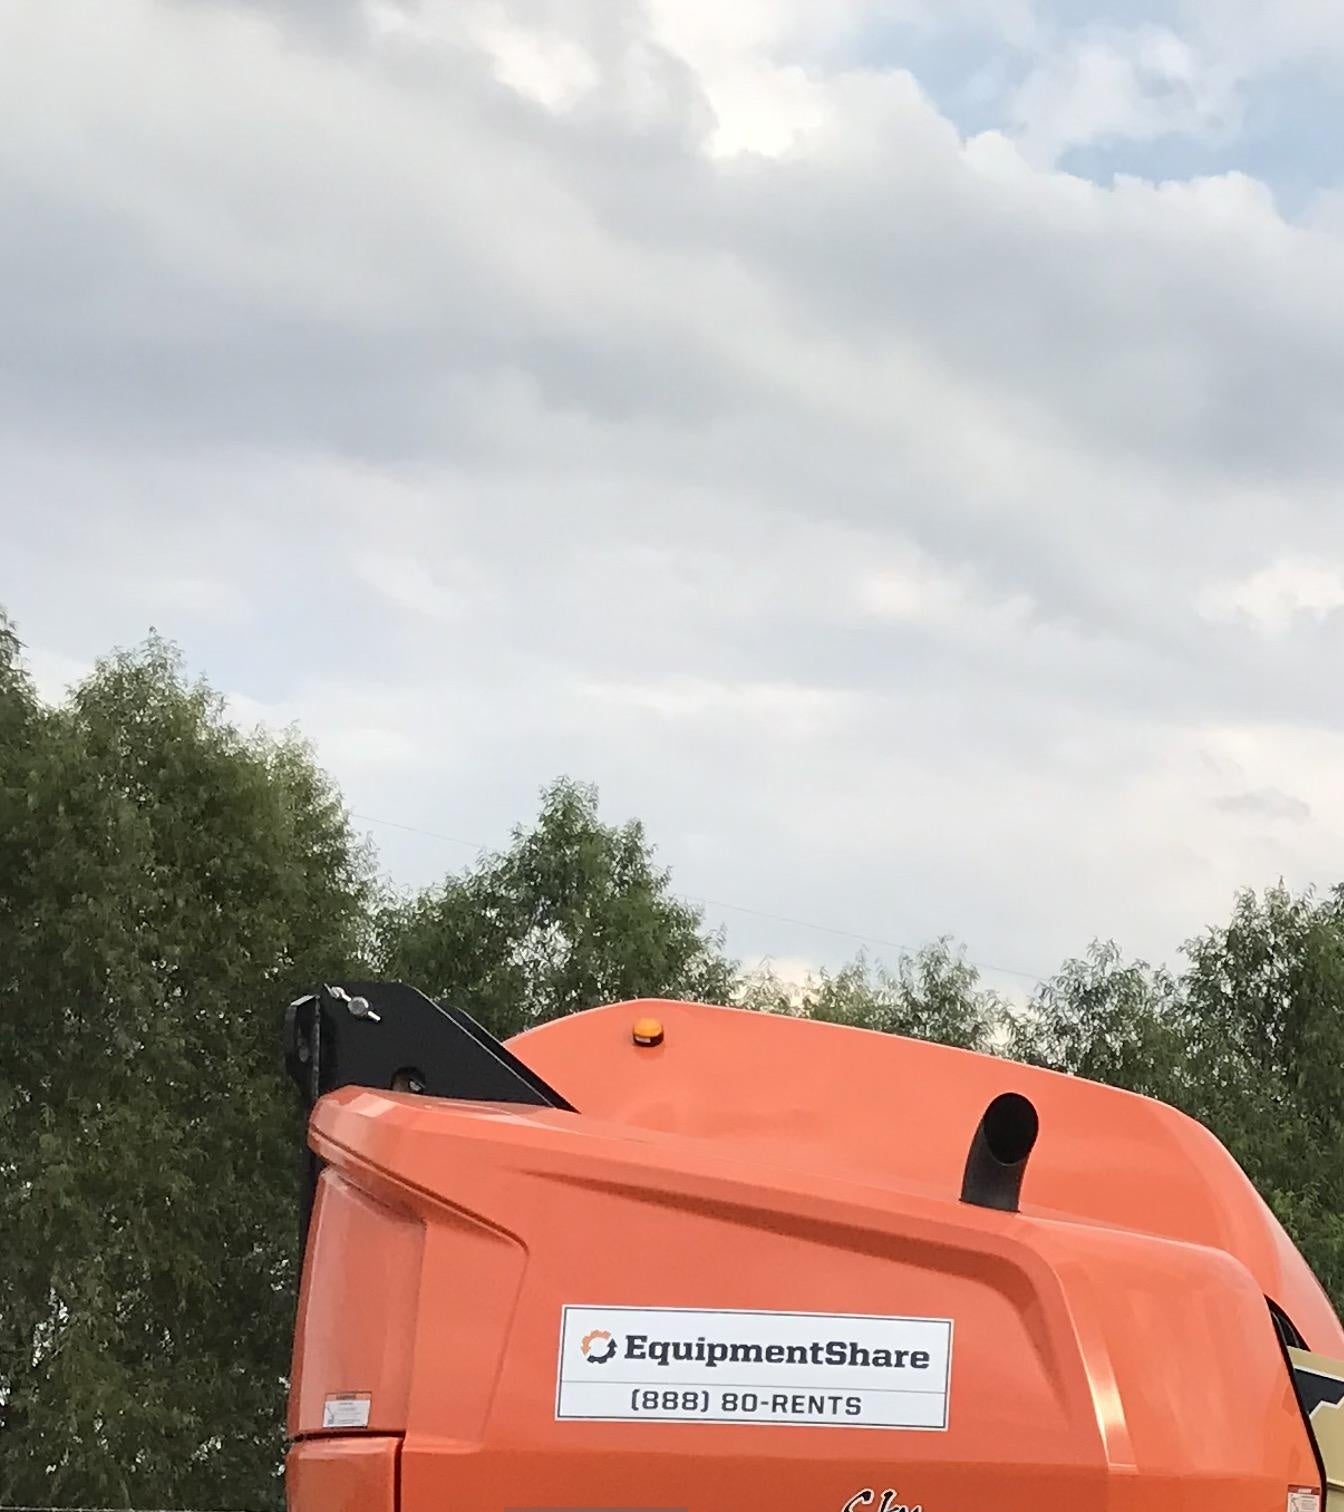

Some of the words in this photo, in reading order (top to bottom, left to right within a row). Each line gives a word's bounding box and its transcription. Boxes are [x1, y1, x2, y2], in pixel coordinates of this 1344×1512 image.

[624, 1335, 930, 1369] EquipmentShare
[631, 1389, 709, 1412] (888)
[720, 1393, 861, 1415] 80-RENTS
